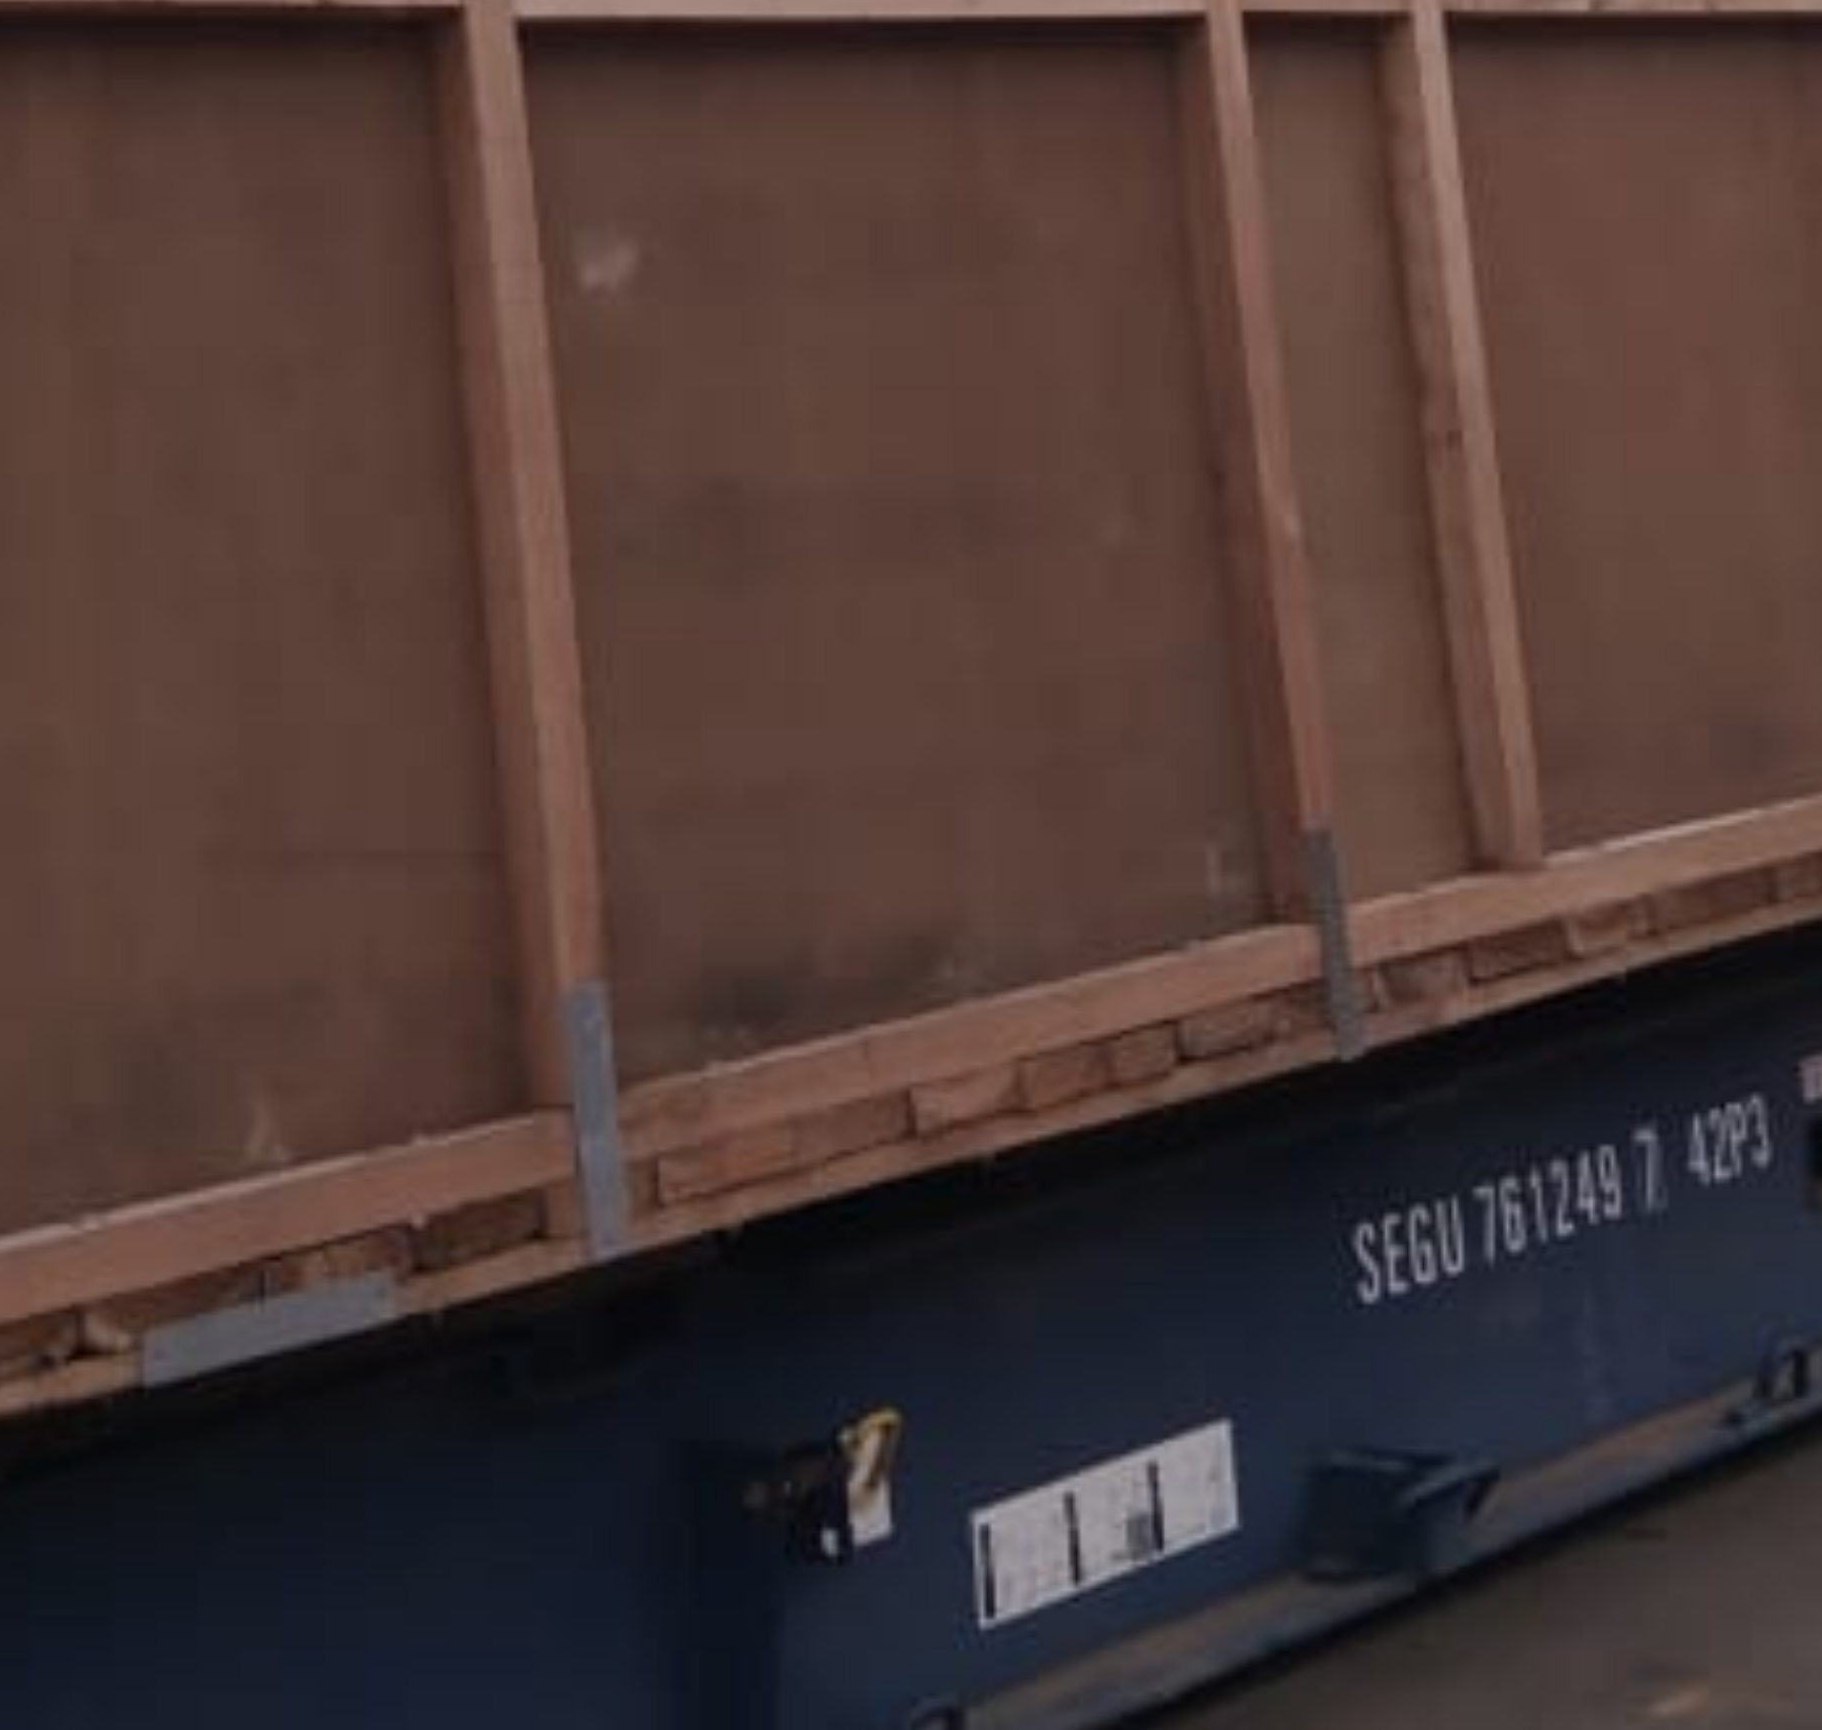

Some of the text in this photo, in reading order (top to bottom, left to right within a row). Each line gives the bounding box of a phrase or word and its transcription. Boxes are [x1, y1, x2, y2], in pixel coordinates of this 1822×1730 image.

[1351, 1092, 1773, 1305] SEGU 761249 7 42P3
